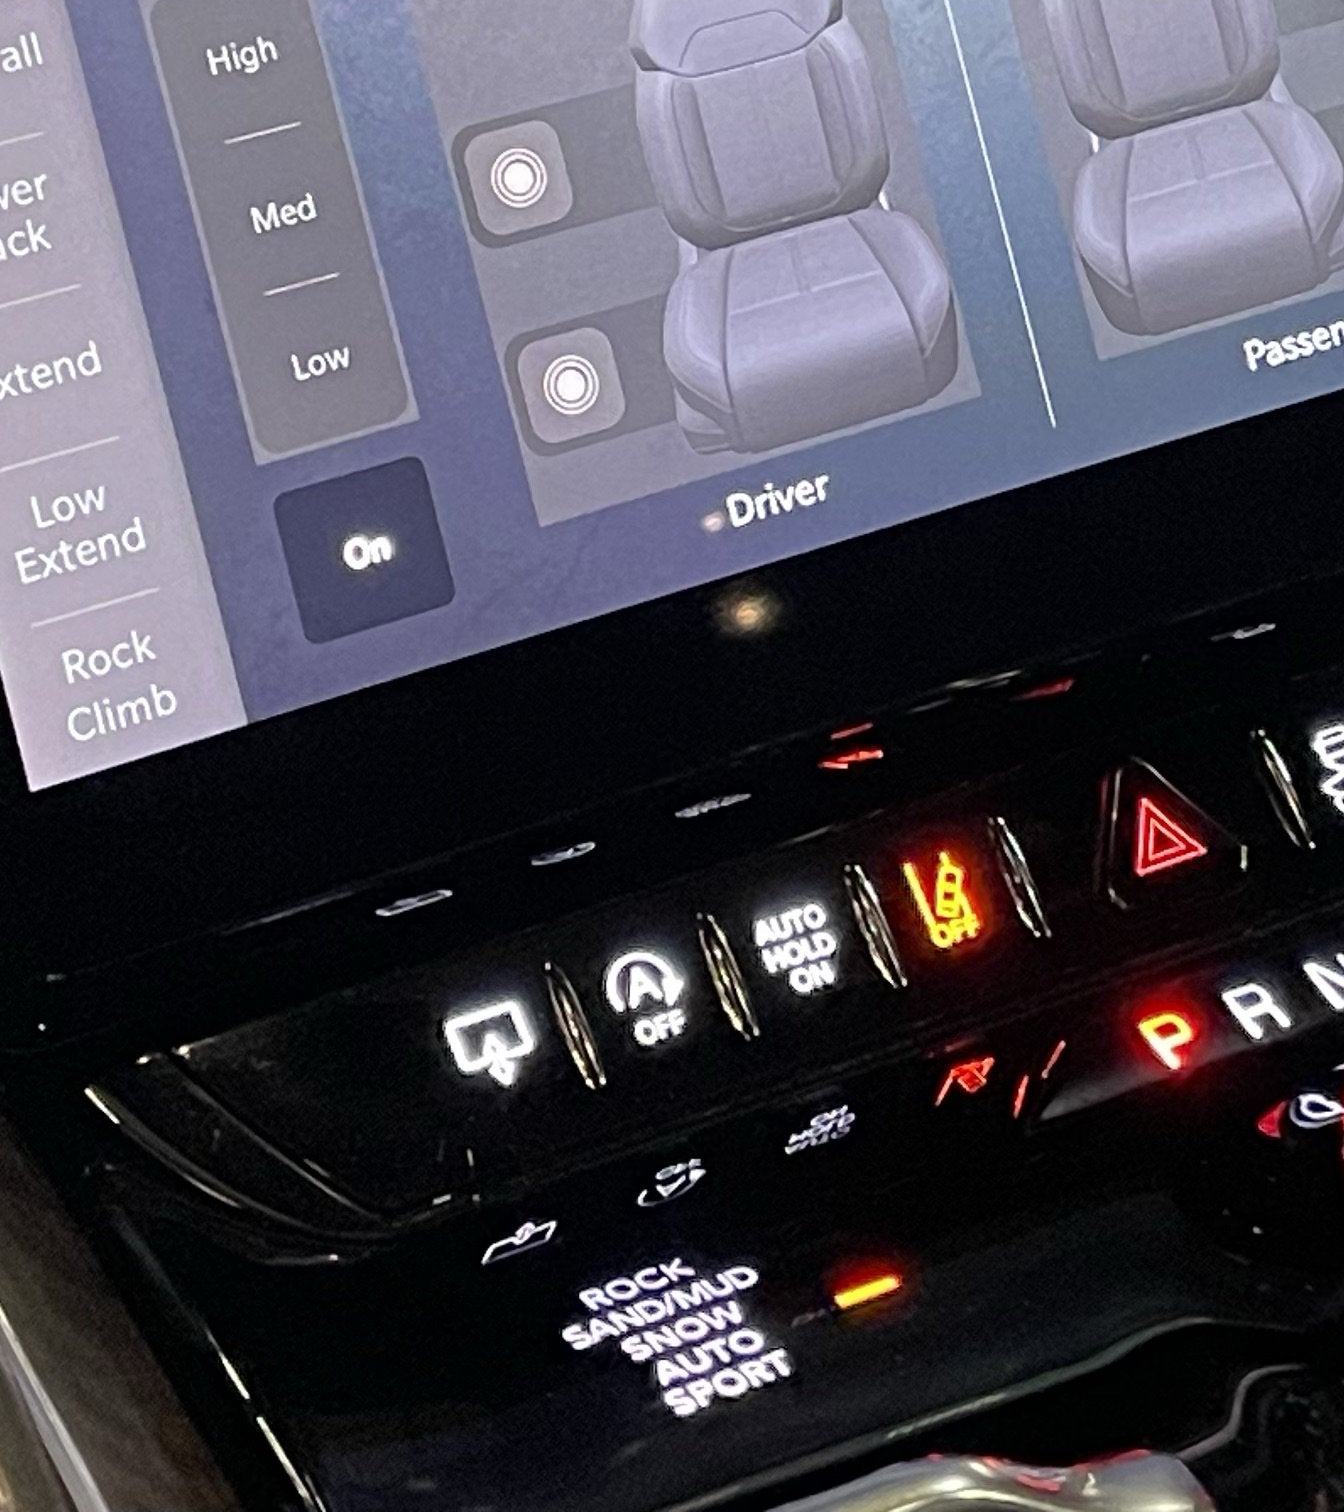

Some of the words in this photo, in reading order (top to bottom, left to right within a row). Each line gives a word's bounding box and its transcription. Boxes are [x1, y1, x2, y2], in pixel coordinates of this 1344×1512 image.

[206, 36, 279, 76] High
[250, 193, 318, 234] Med
[291, 346, 351, 382] Low
[30, 485, 106, 530] Low
[725, 471, 831, 529] Driver
[15, 517, 147, 585] Extend
[342, 532, 394, 570] On
[61, 630, 157, 684] Rock
[66, 685, 178, 743] Climb
[756, 904, 826, 946] AUTO
[931, 913, 980, 948] OFF
[761, 932, 837, 973] HOLD
[789, 961, 835, 992] ON
[635, 1009, 685, 1045] OFF
[1137, 1013, 1194, 1070] P
[1222, 983, 1292, 1039] R
[562, 1265, 759, 1351] SAND/MUD
[579, 1258, 696, 1312] ROCK
[621, 1300, 743, 1362] SNOW
[657, 1329, 765, 1388] AUTO
[663, 1348, 795, 1417] SPORT
